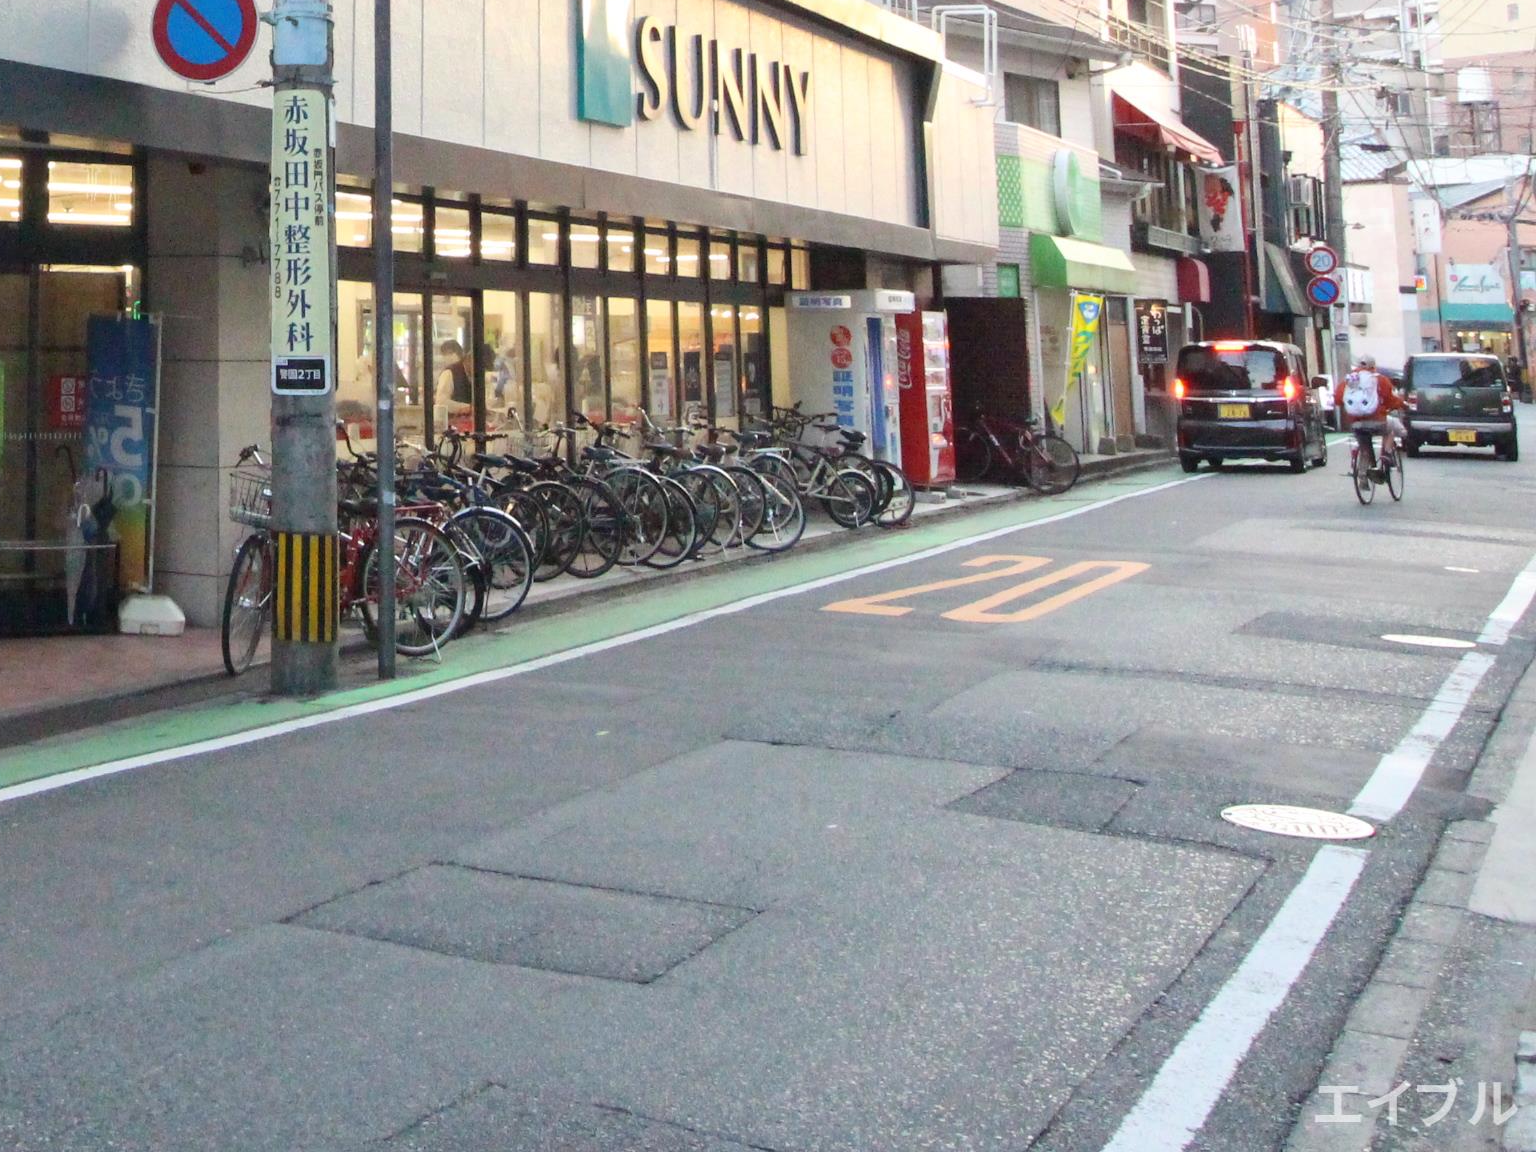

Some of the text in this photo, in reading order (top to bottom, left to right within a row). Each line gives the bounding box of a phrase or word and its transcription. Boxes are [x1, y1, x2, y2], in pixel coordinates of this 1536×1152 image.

[636, 15, 809, 157] SUNNY
[284, 95, 314, 352] 赤坂田中整形外科
[1312, 253, 1332, 268] 20
[819, 554, 1152, 623] 20
